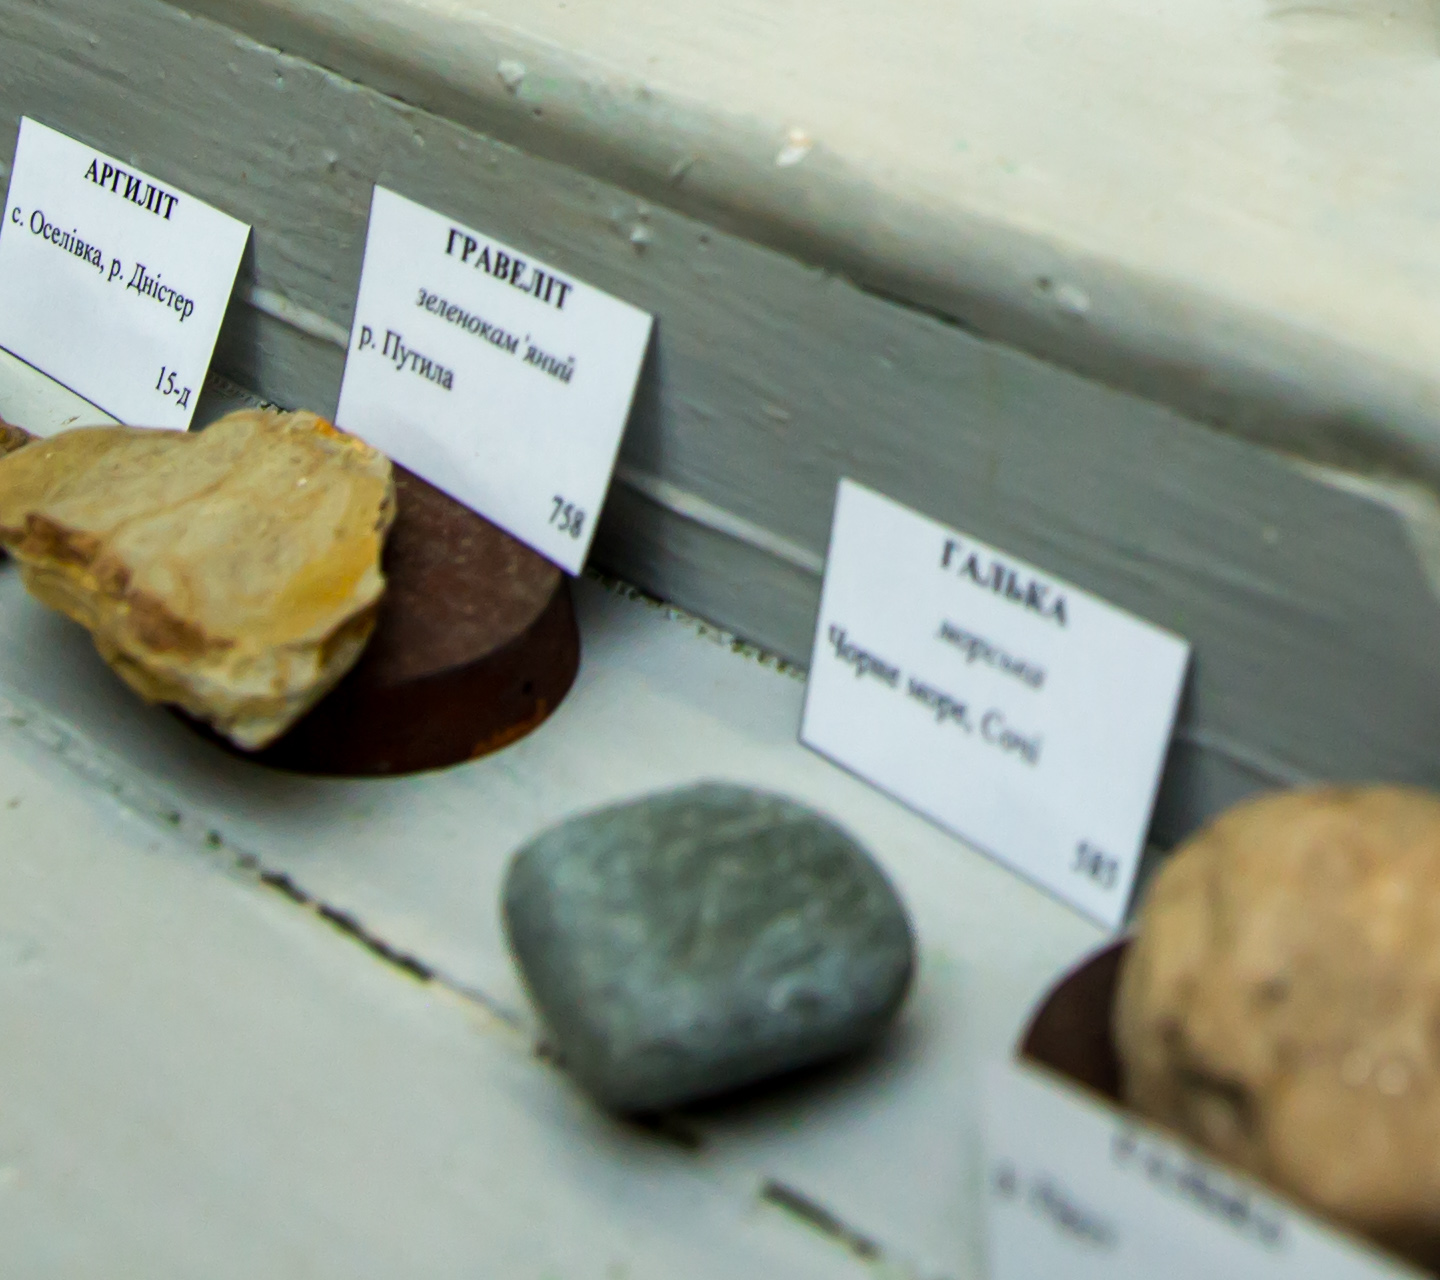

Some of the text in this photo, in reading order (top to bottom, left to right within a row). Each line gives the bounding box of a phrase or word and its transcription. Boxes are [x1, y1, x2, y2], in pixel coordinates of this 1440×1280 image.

[84, 158, 179, 221] АРГИЛІТ
[11, 206, 194, 322] с. Оселівка, р. Дністер
[445, 227, 574, 311] ГРАВЕЛІТ
[358, 325, 456, 392] р. Путила
[548, 494, 586, 540] 758
[940, 538, 1071, 627] ГАЛЬКА
